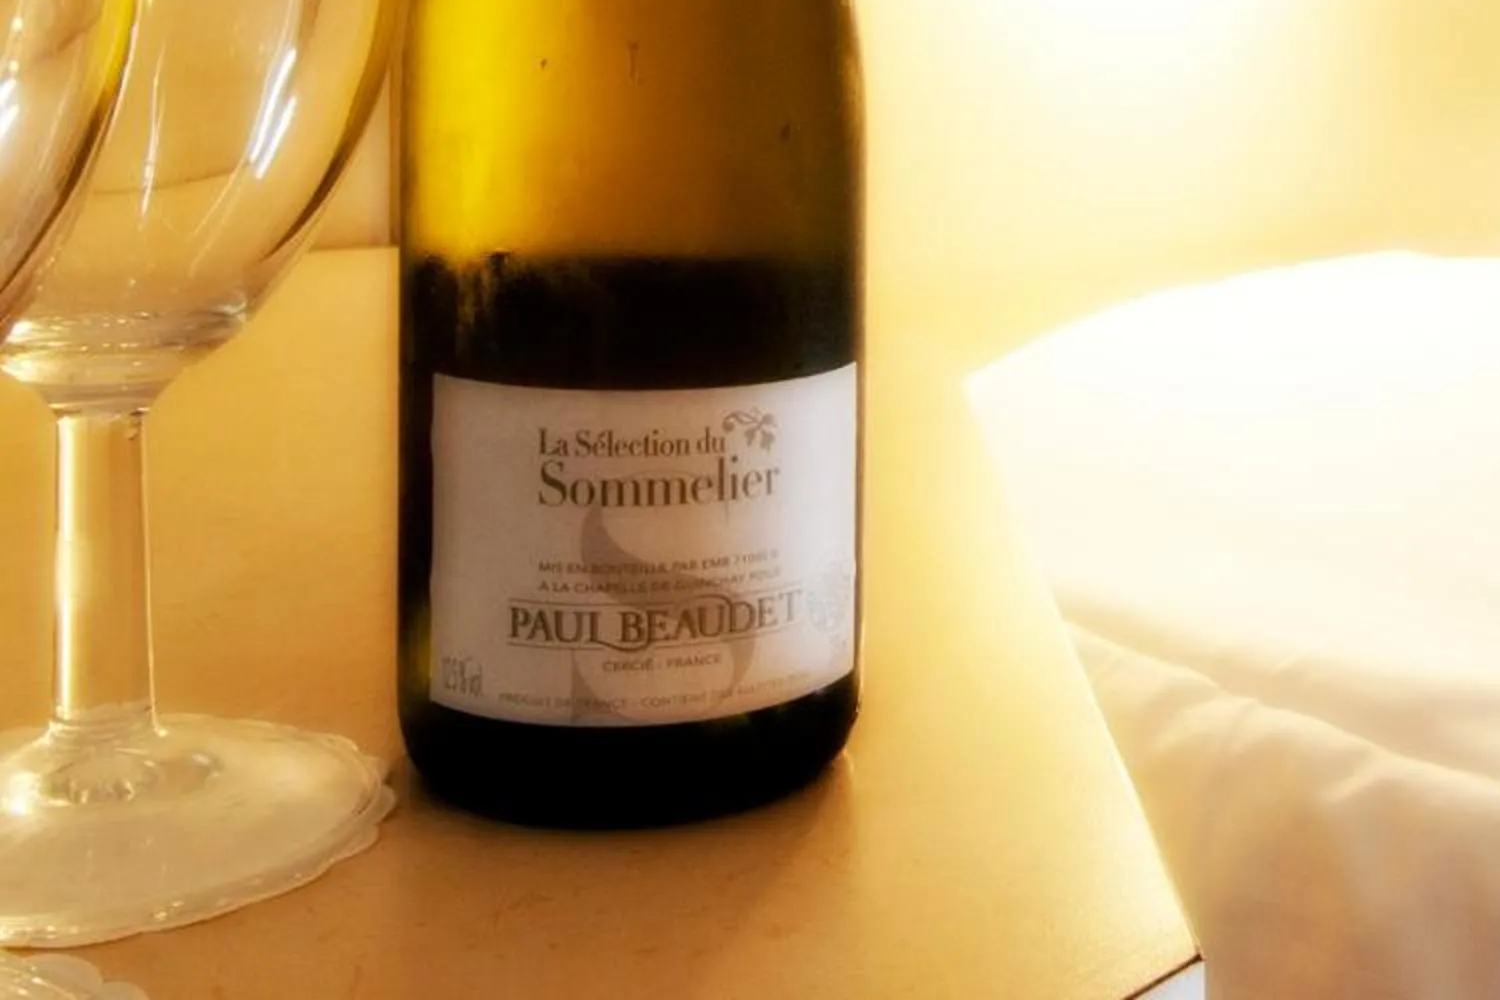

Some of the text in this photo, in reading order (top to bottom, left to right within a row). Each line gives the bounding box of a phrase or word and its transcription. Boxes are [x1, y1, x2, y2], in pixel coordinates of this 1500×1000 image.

[538, 426, 726, 457] La Sélection du
[537, 455, 782, 508] Sommelier
[507, 590, 803, 645] PAUL BEAUDET
